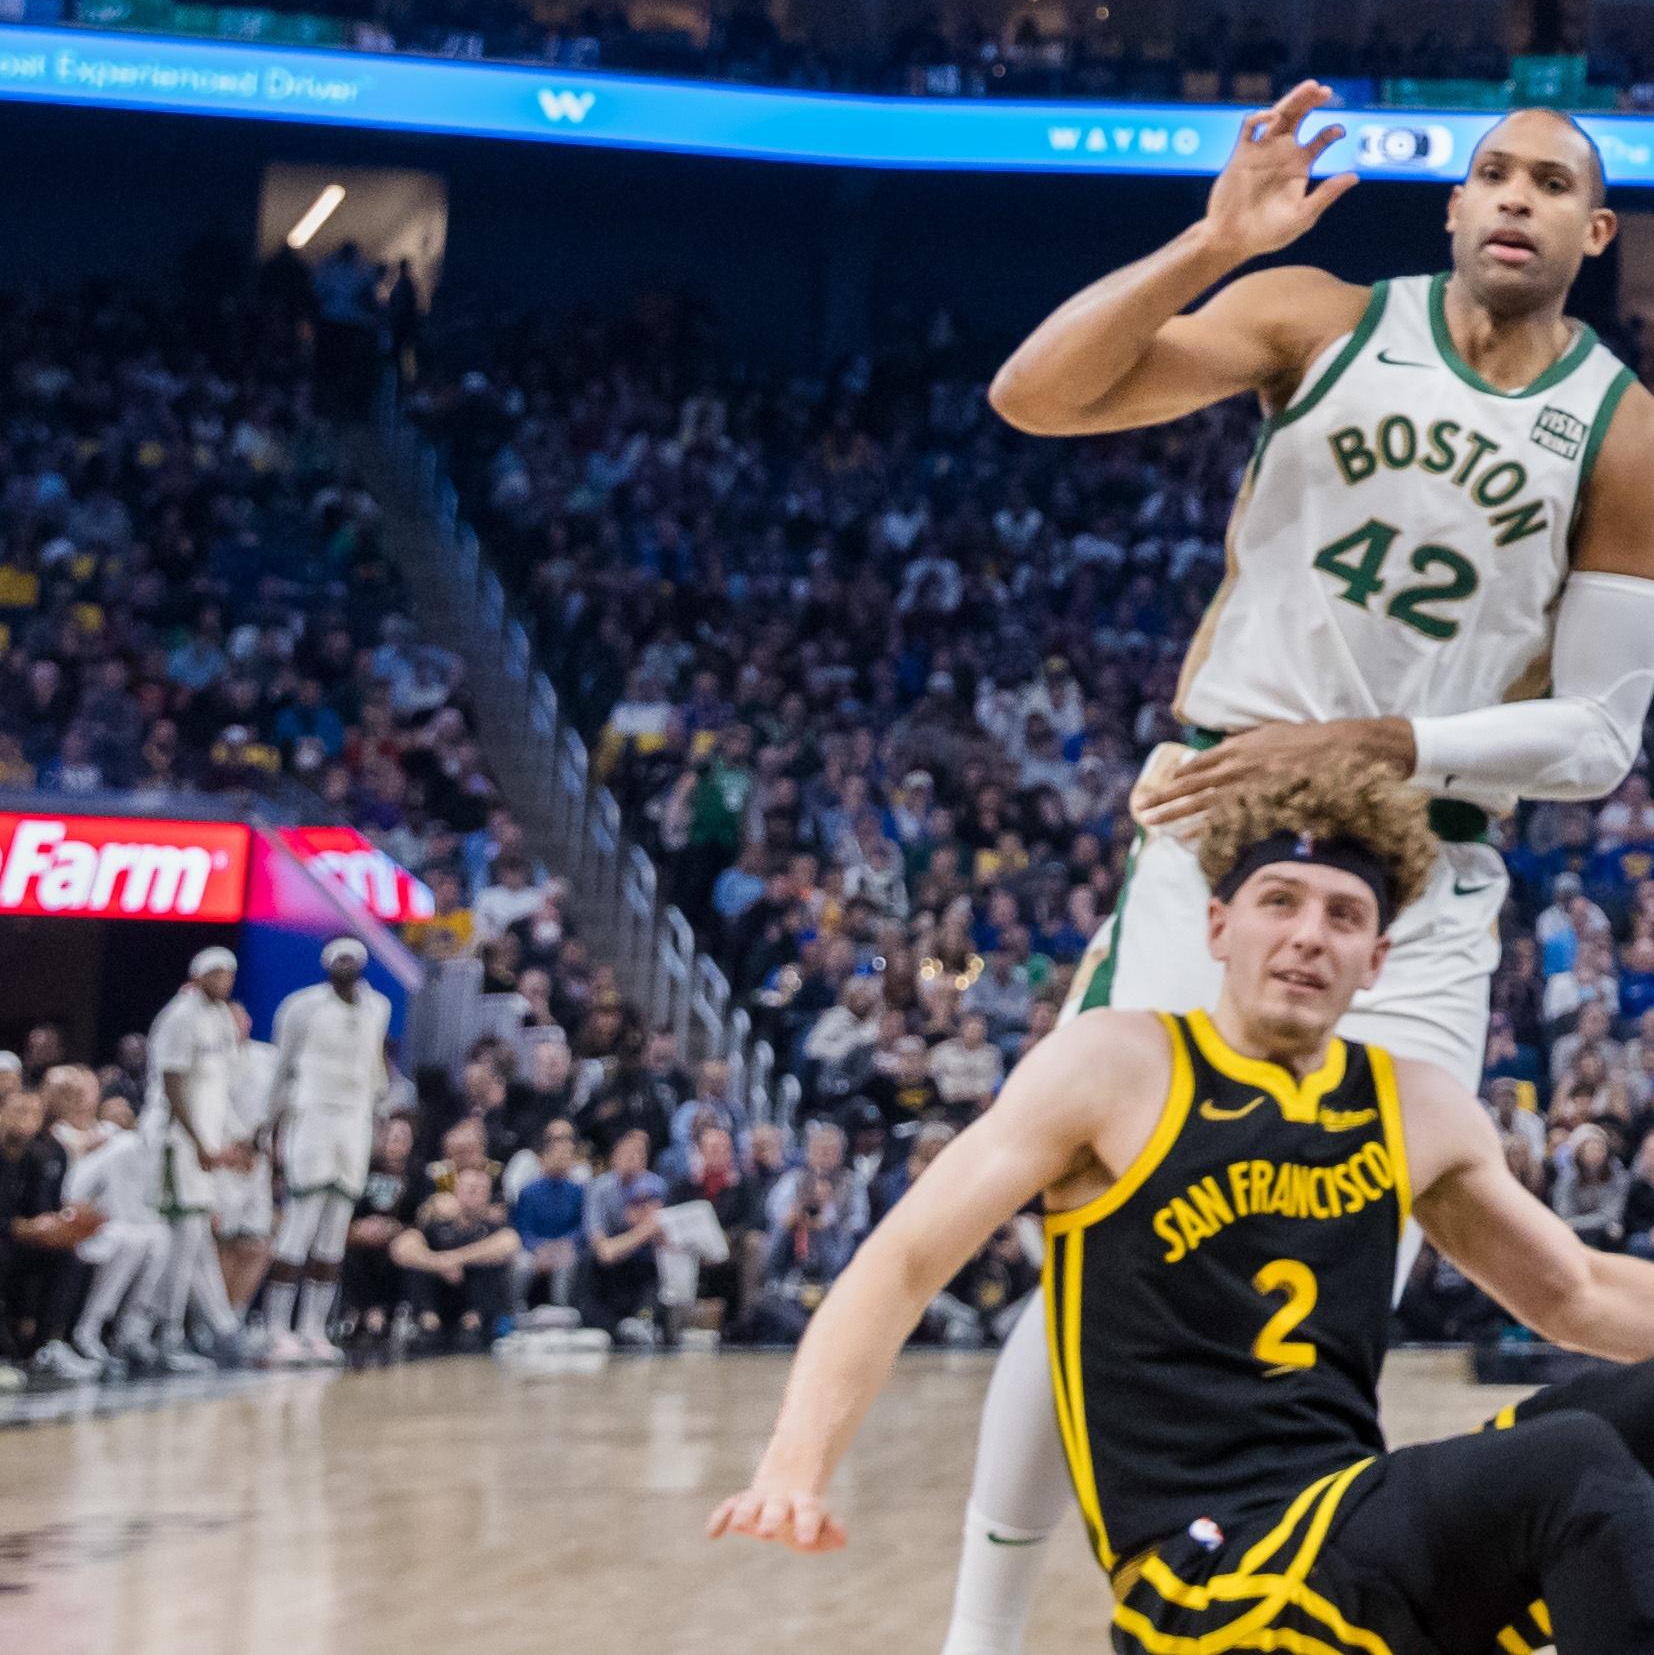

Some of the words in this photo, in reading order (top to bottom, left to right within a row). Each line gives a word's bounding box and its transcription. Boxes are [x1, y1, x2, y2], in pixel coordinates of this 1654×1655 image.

[1048, 128, 1200, 155] WAYMO
[1328, 413, 1548, 548] BOSTON
[1312, 517, 1479, 642] 42
[0, 820, 212, 914] Farm
[1152, 1176, 1237, 1264] SAN
[1227, 1141, 1394, 1220] FRANCISCO
[1251, 1259, 1318, 1369] 2
